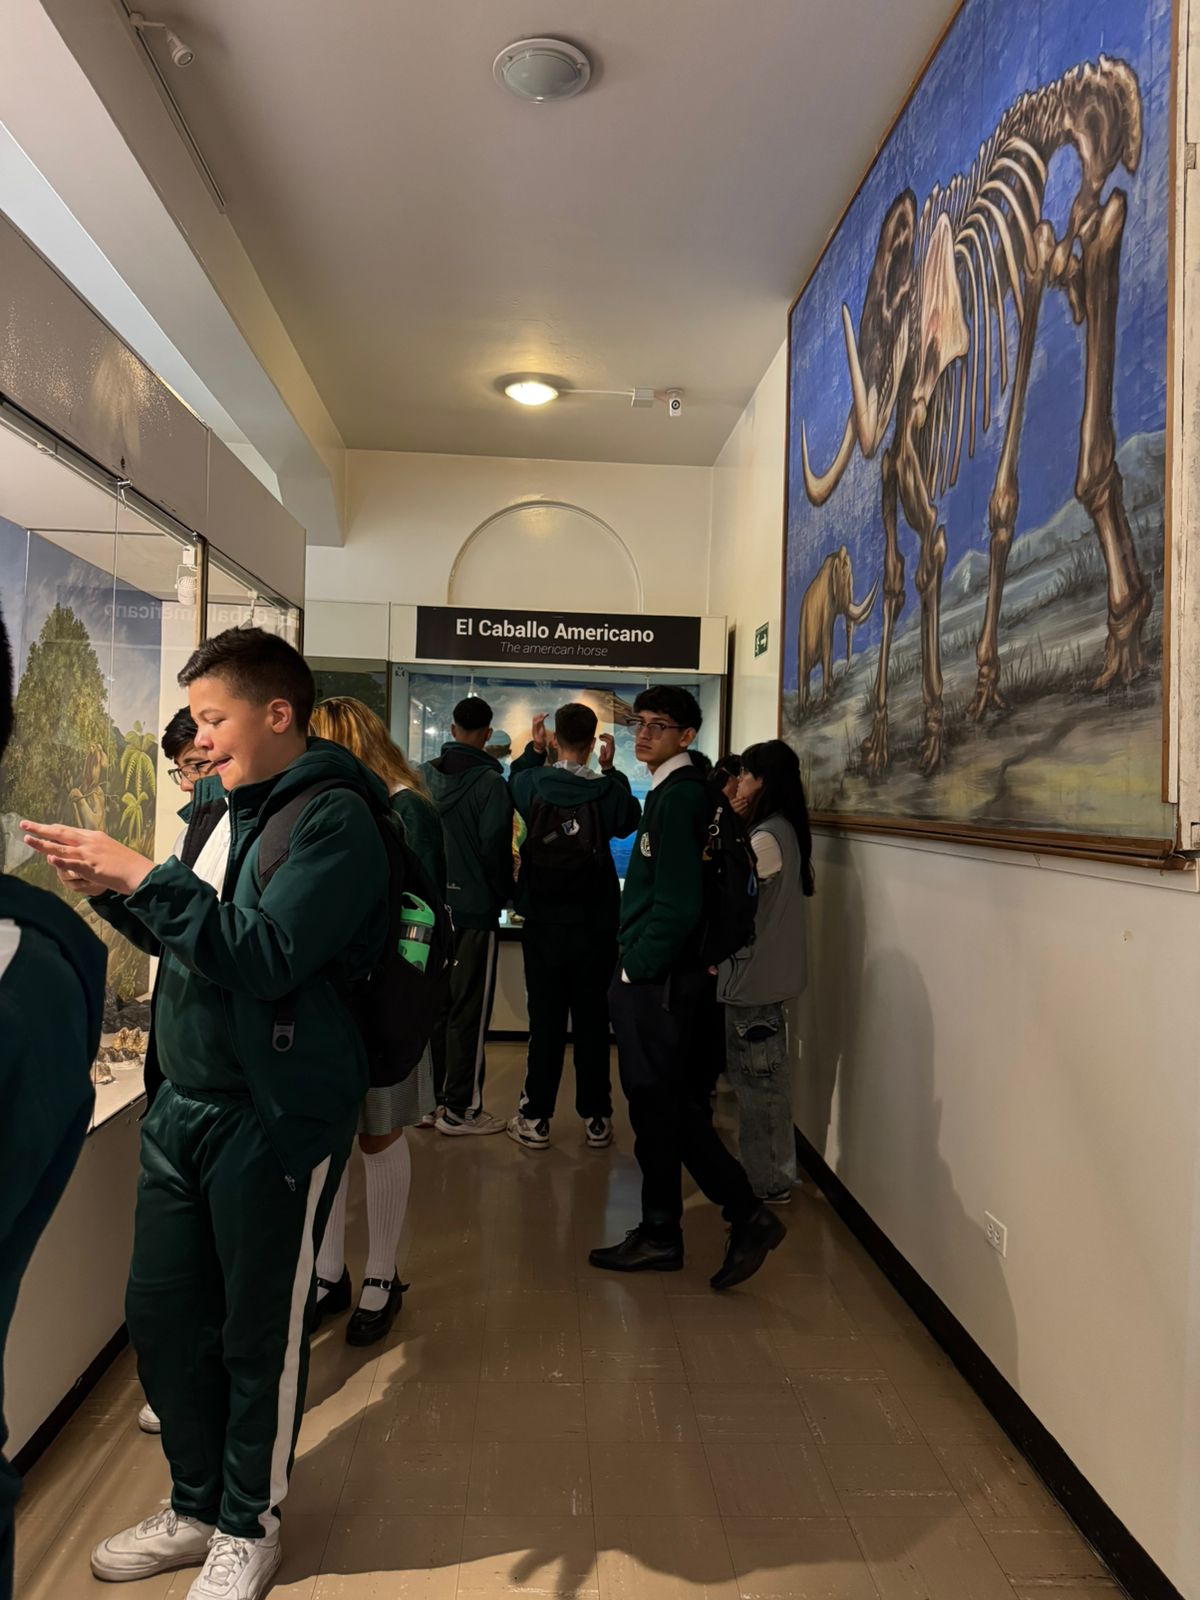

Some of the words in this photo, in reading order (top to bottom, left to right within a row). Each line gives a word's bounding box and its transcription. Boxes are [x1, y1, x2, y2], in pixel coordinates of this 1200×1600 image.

[456, 618, 473, 635] El
[478, 619, 549, 639] Caballo
[554, 622, 654, 643] Americano
[501, 641, 521, 653] The
[522, 643, 574, 655] american
[576, 644, 608, 657] horse
